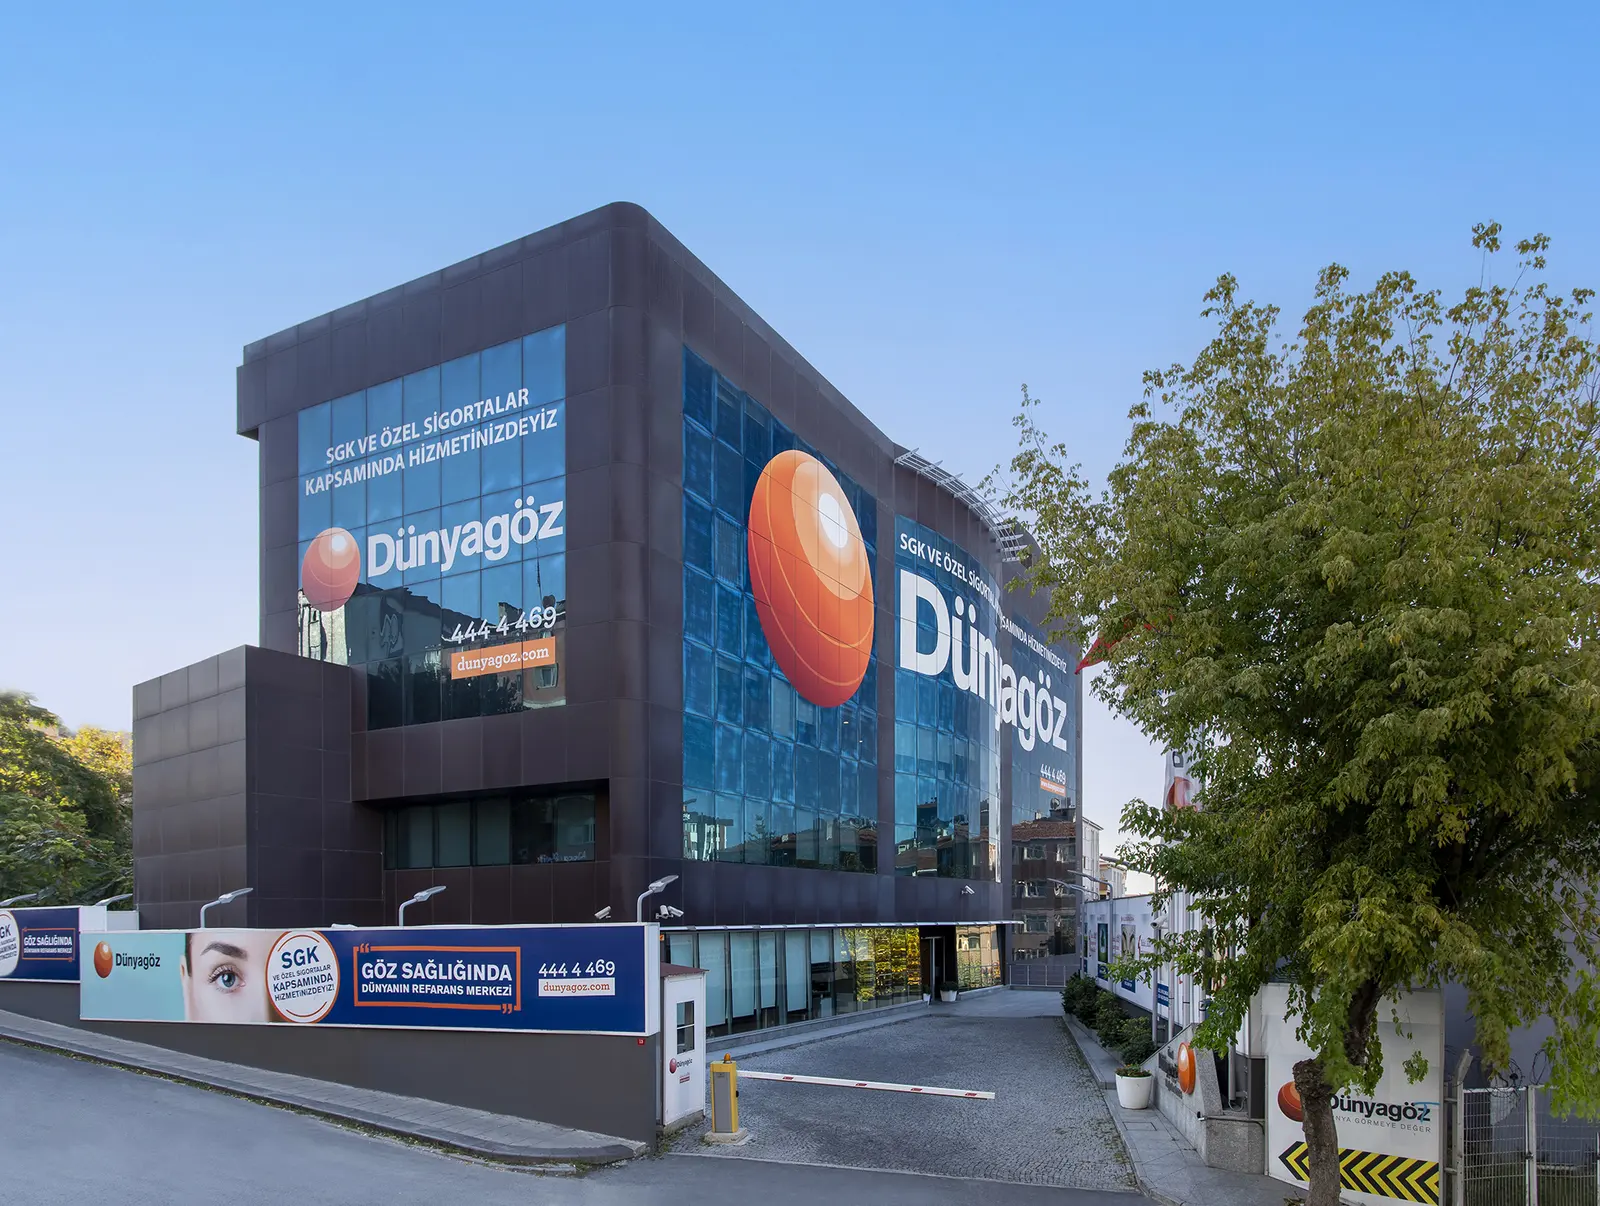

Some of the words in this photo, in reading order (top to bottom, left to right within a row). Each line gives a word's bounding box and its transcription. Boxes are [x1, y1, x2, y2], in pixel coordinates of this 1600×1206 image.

[326, 440, 356, 465] SGK
[358, 433, 377, 455] VE
[380, 421, 420, 448] ÖZEL
[423, 388, 530, 436] SİGORTALAR
[305, 453, 405, 496] KAPSAMINDA
[408, 407, 558, 468] HİZMETİNİZDEYİZ
[367, 495, 564, 579] Dünyagöz
[900, 532, 926, 560] SGK
[927, 545, 942, 568] VE
[943, 551, 968, 583] ÖZEL
[451, 622, 491, 645] 444
[496, 614, 510, 637] 4
[515, 605, 557, 634] 469
[457, 646, 550, 672] dunyagoz.com
[115, 952, 161, 971] Dünyagöz
[281, 945, 320, 970] SGK
[538, 962, 568, 977] 444
[571, 962, 582, 977] 4
[585, 958, 616, 976] 469
[280, 971, 296, 980] ÖZEL
[361, 959, 398, 979] GÖZ
[401, 959, 513, 981] SAĞLIĞINDA
[273, 973, 334, 992] KAPSAMINDA
[361, 982, 410, 993] DÜNYANIN
[412, 983, 464, 995] REFARANS
[466, 984, 512, 996] MERKEZİ
[543, 982, 610, 993] dunyagoz.com
